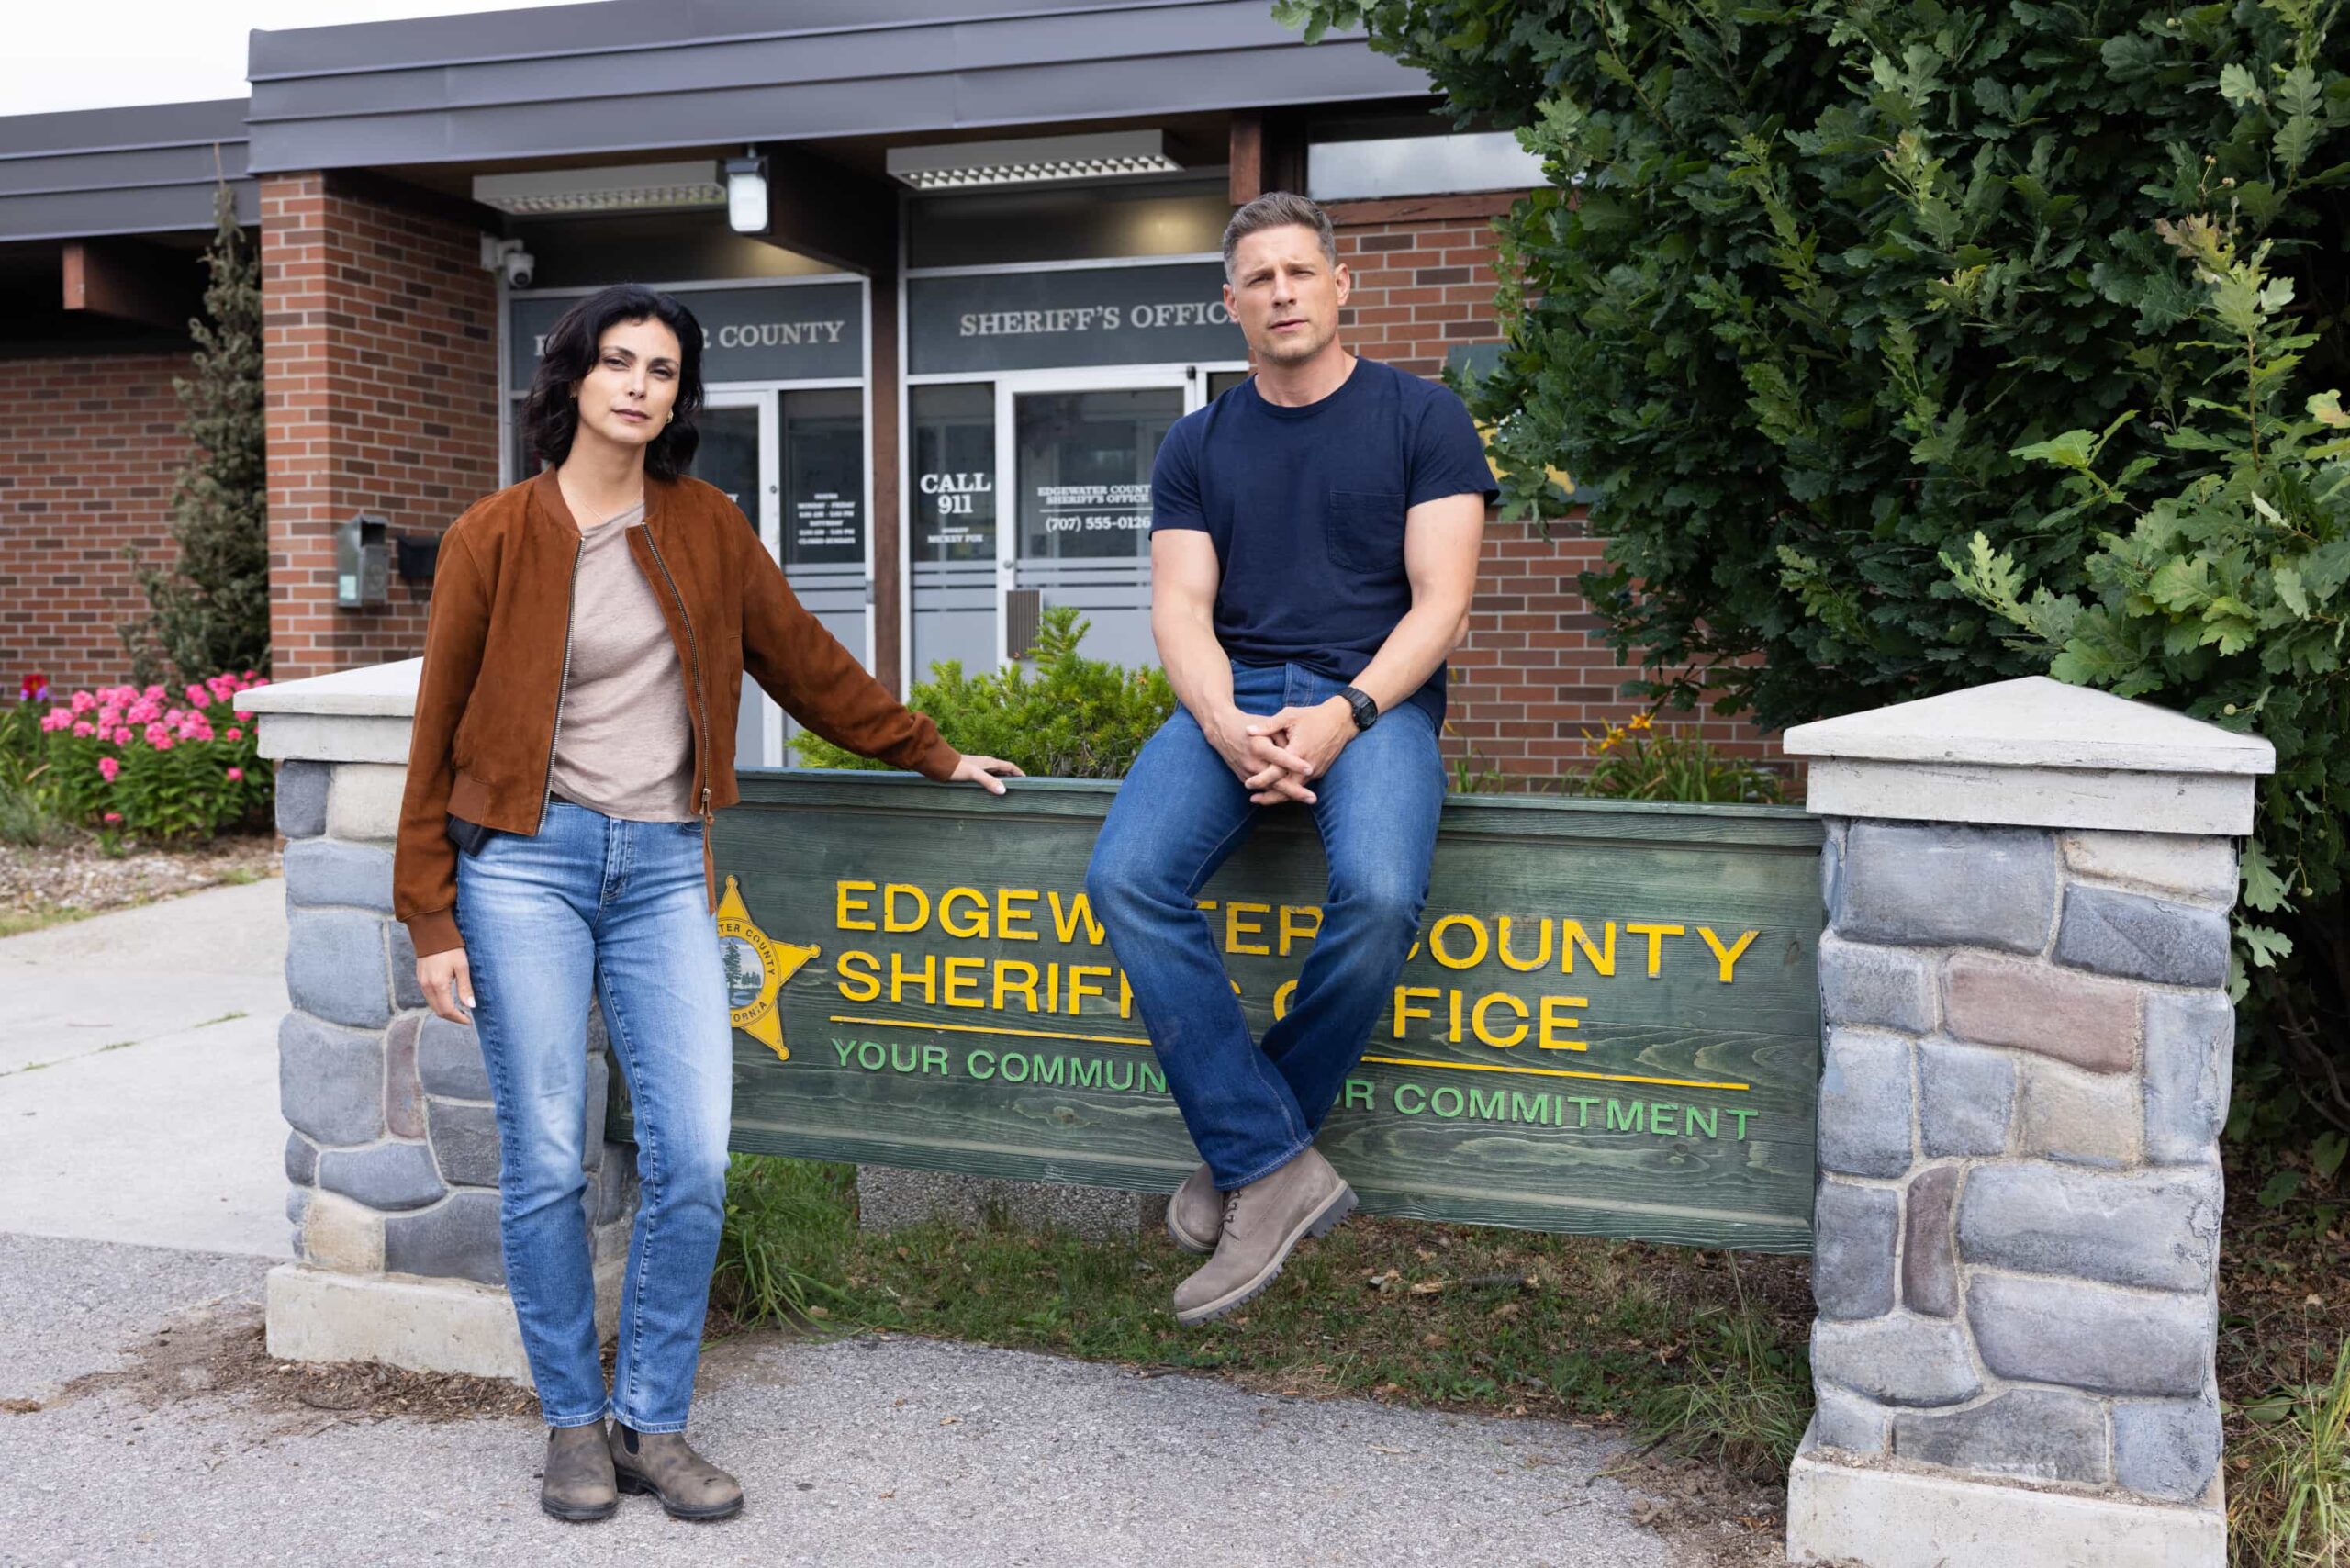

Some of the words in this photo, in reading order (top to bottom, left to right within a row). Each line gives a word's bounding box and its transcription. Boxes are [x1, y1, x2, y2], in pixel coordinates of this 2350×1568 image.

[960, 305, 1120, 336] SHERIFF'S
[1130, 301, 1229, 328] OFFIC
[718, 321, 845, 348] COUNTY
[920, 473, 991, 494] CALL
[1037, 486, 1108, 497] EDGEWATER
[1110, 485, 1152, 495] COUNT
[937, 494, 974, 515] 911
[1046, 495, 1104, 504] SHERIFF'S
[1106, 494, 1149, 503] OFFICE
[1046, 516, 1081, 532] (707)
[1085, 515, 1152, 530] 555-0126
[745, 928, 776, 976] COUNTY
[1406, 913, 1761, 984] OUNTY
[831, 1037, 949, 1076] YOUR
[1393, 1082, 1760, 1141] COMMITMENT
